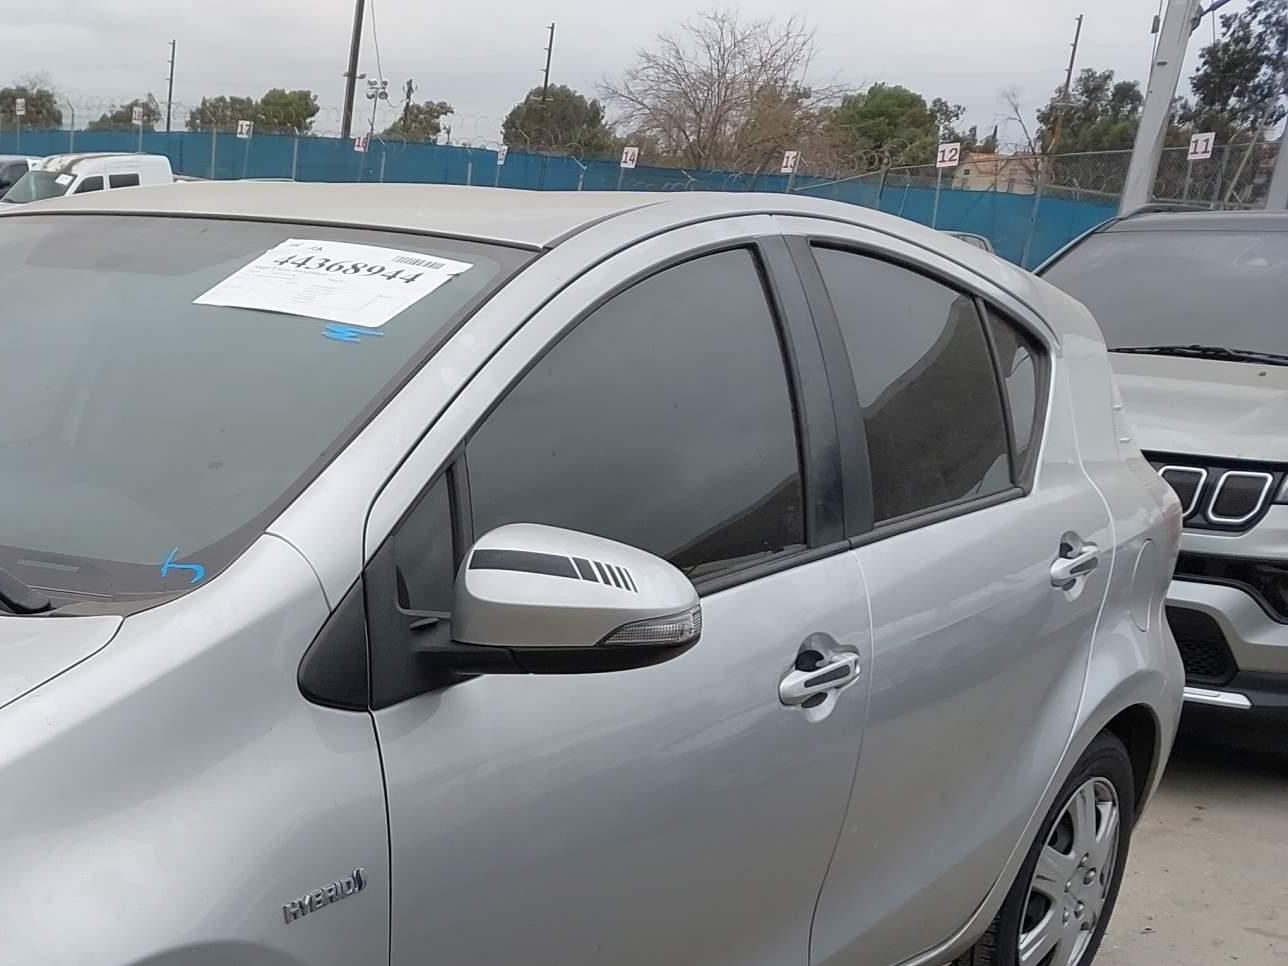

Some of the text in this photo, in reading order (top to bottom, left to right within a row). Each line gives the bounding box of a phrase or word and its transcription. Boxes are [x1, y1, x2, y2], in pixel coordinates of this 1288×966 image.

[938, 147, 958, 163] 12
[1189, 137, 1212, 155] 11
[622, 150, 636, 164] 14
[273, 254, 425, 284] 44368944
[281, 876, 359, 925] HYBRID
